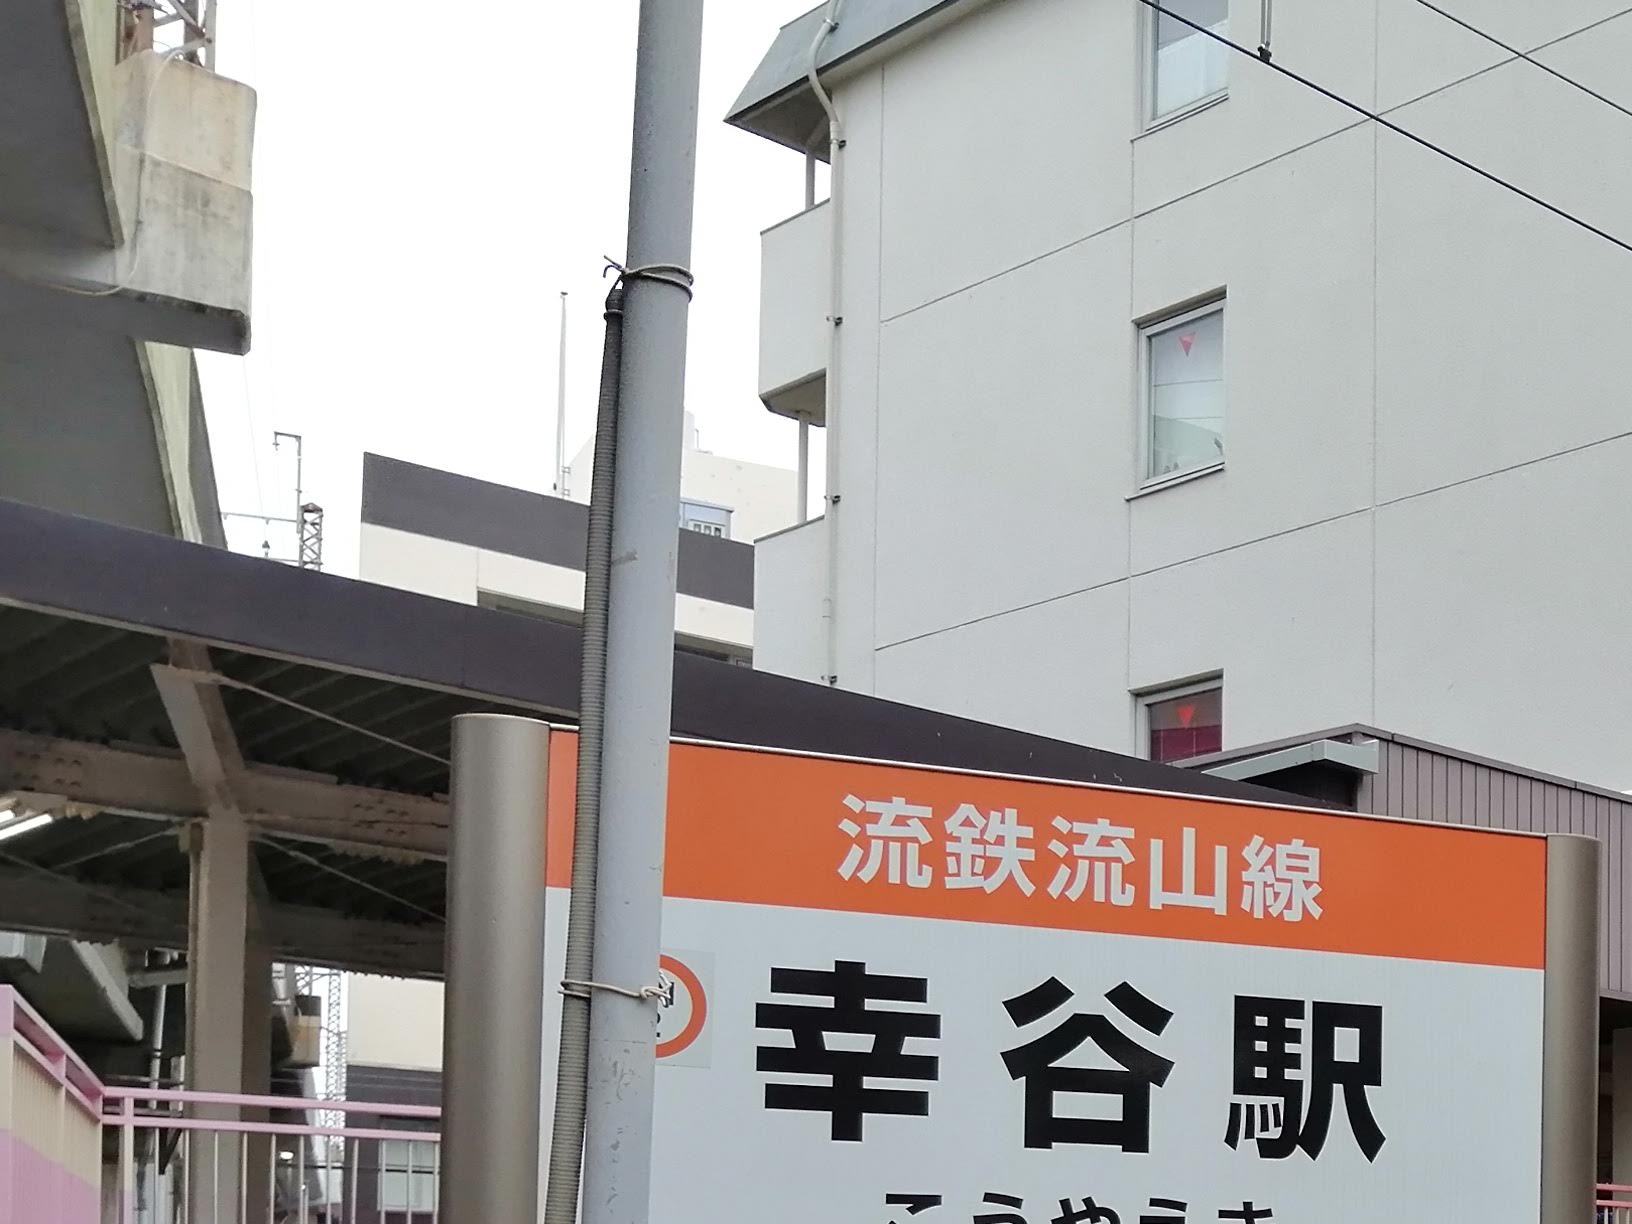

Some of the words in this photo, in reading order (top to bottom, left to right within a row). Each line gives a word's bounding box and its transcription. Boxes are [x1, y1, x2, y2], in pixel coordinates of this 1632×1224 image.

[838, 794, 1323, 922] 流鉄流山線
[755, 960, 1386, 1162] 幸谷駅
